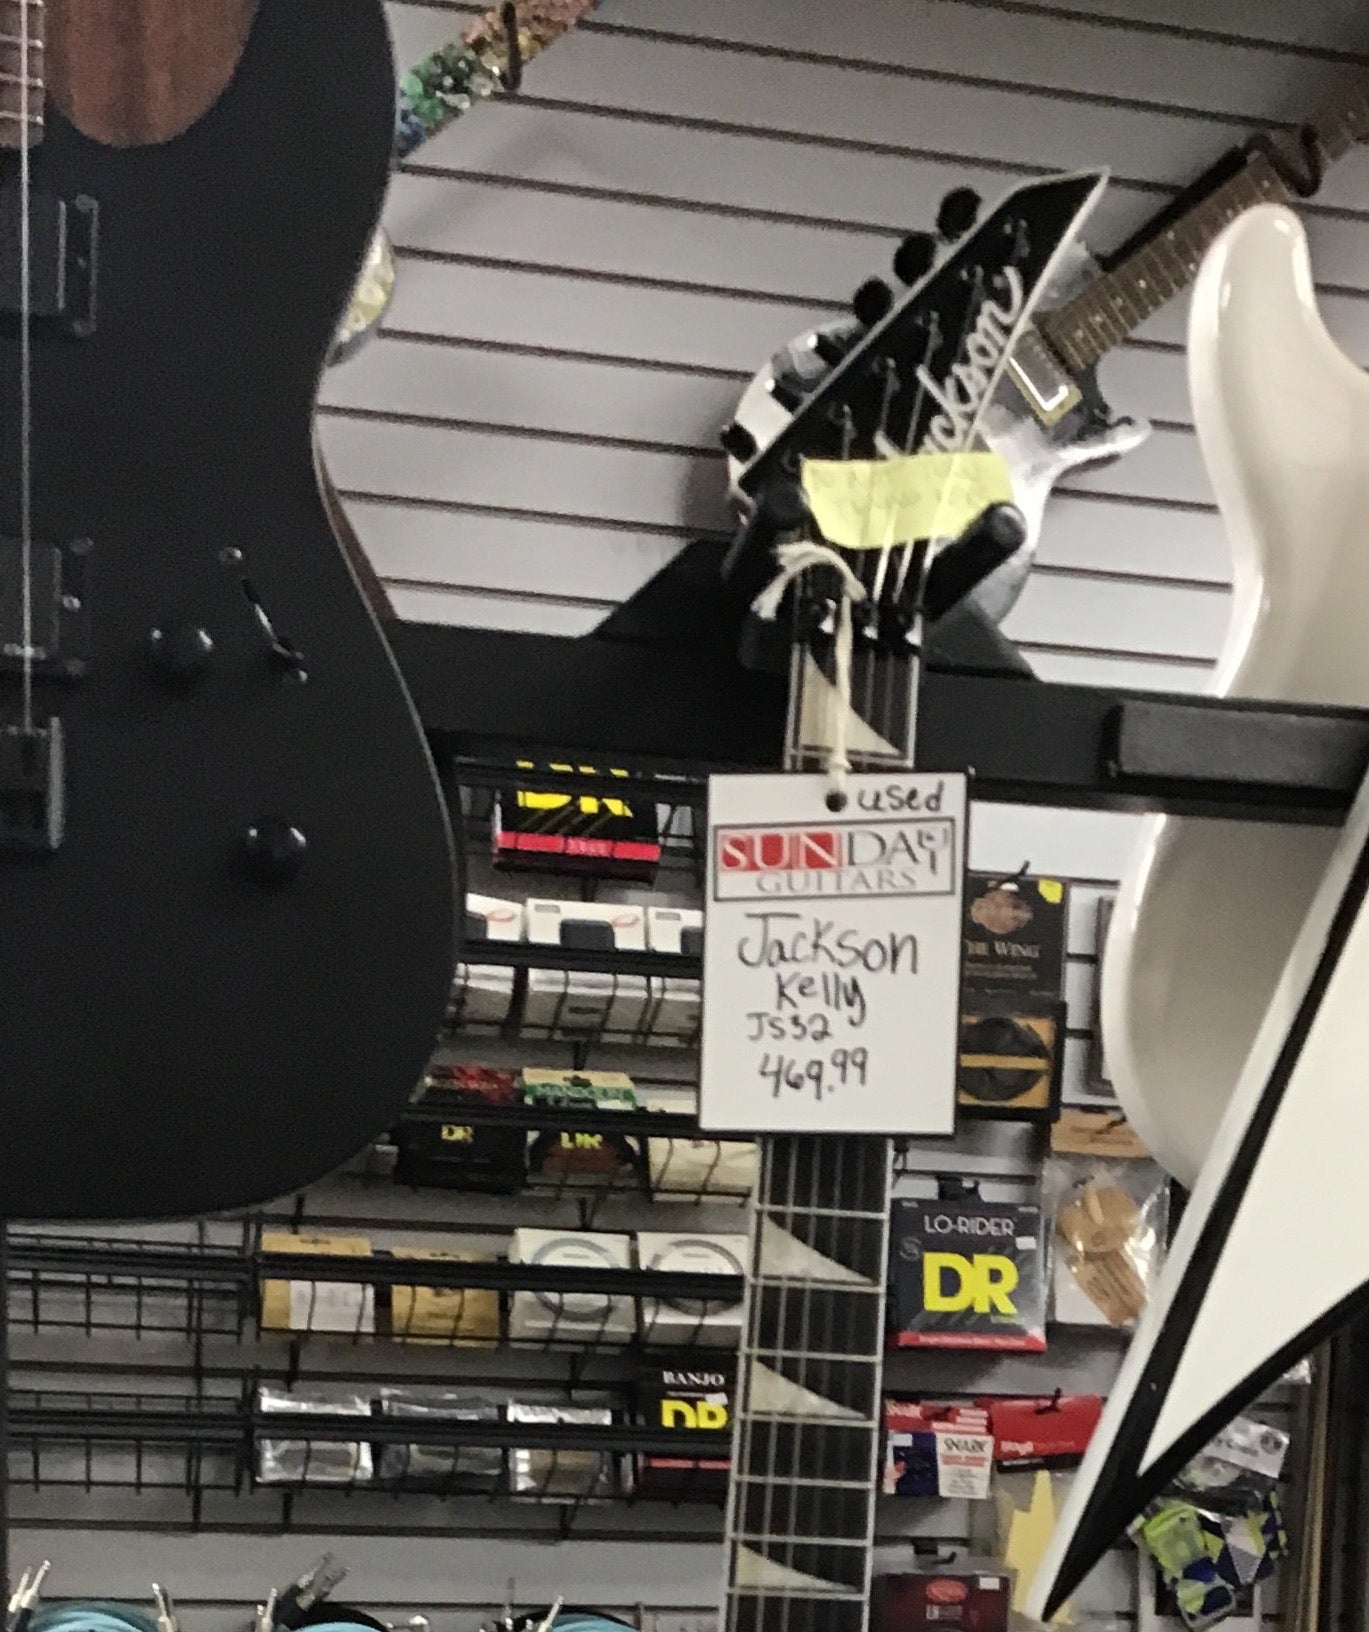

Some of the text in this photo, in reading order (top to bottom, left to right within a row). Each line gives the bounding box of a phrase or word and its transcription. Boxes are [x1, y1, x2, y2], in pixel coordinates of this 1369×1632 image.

[857, 780, 944, 812] used
[756, 869, 917, 894] GUITARS
[738, 911, 918, 975] Jackson
[776, 971, 867, 1028] Kelly
[745, 1011, 831, 1042] JS32
[759, 1046, 869, 1101] 469.99
[923, 1214, 1016, 1237] LO-RIDER
[922, 1252, 1020, 1315] DR
[662, 1370, 725, 1387] BANJO
